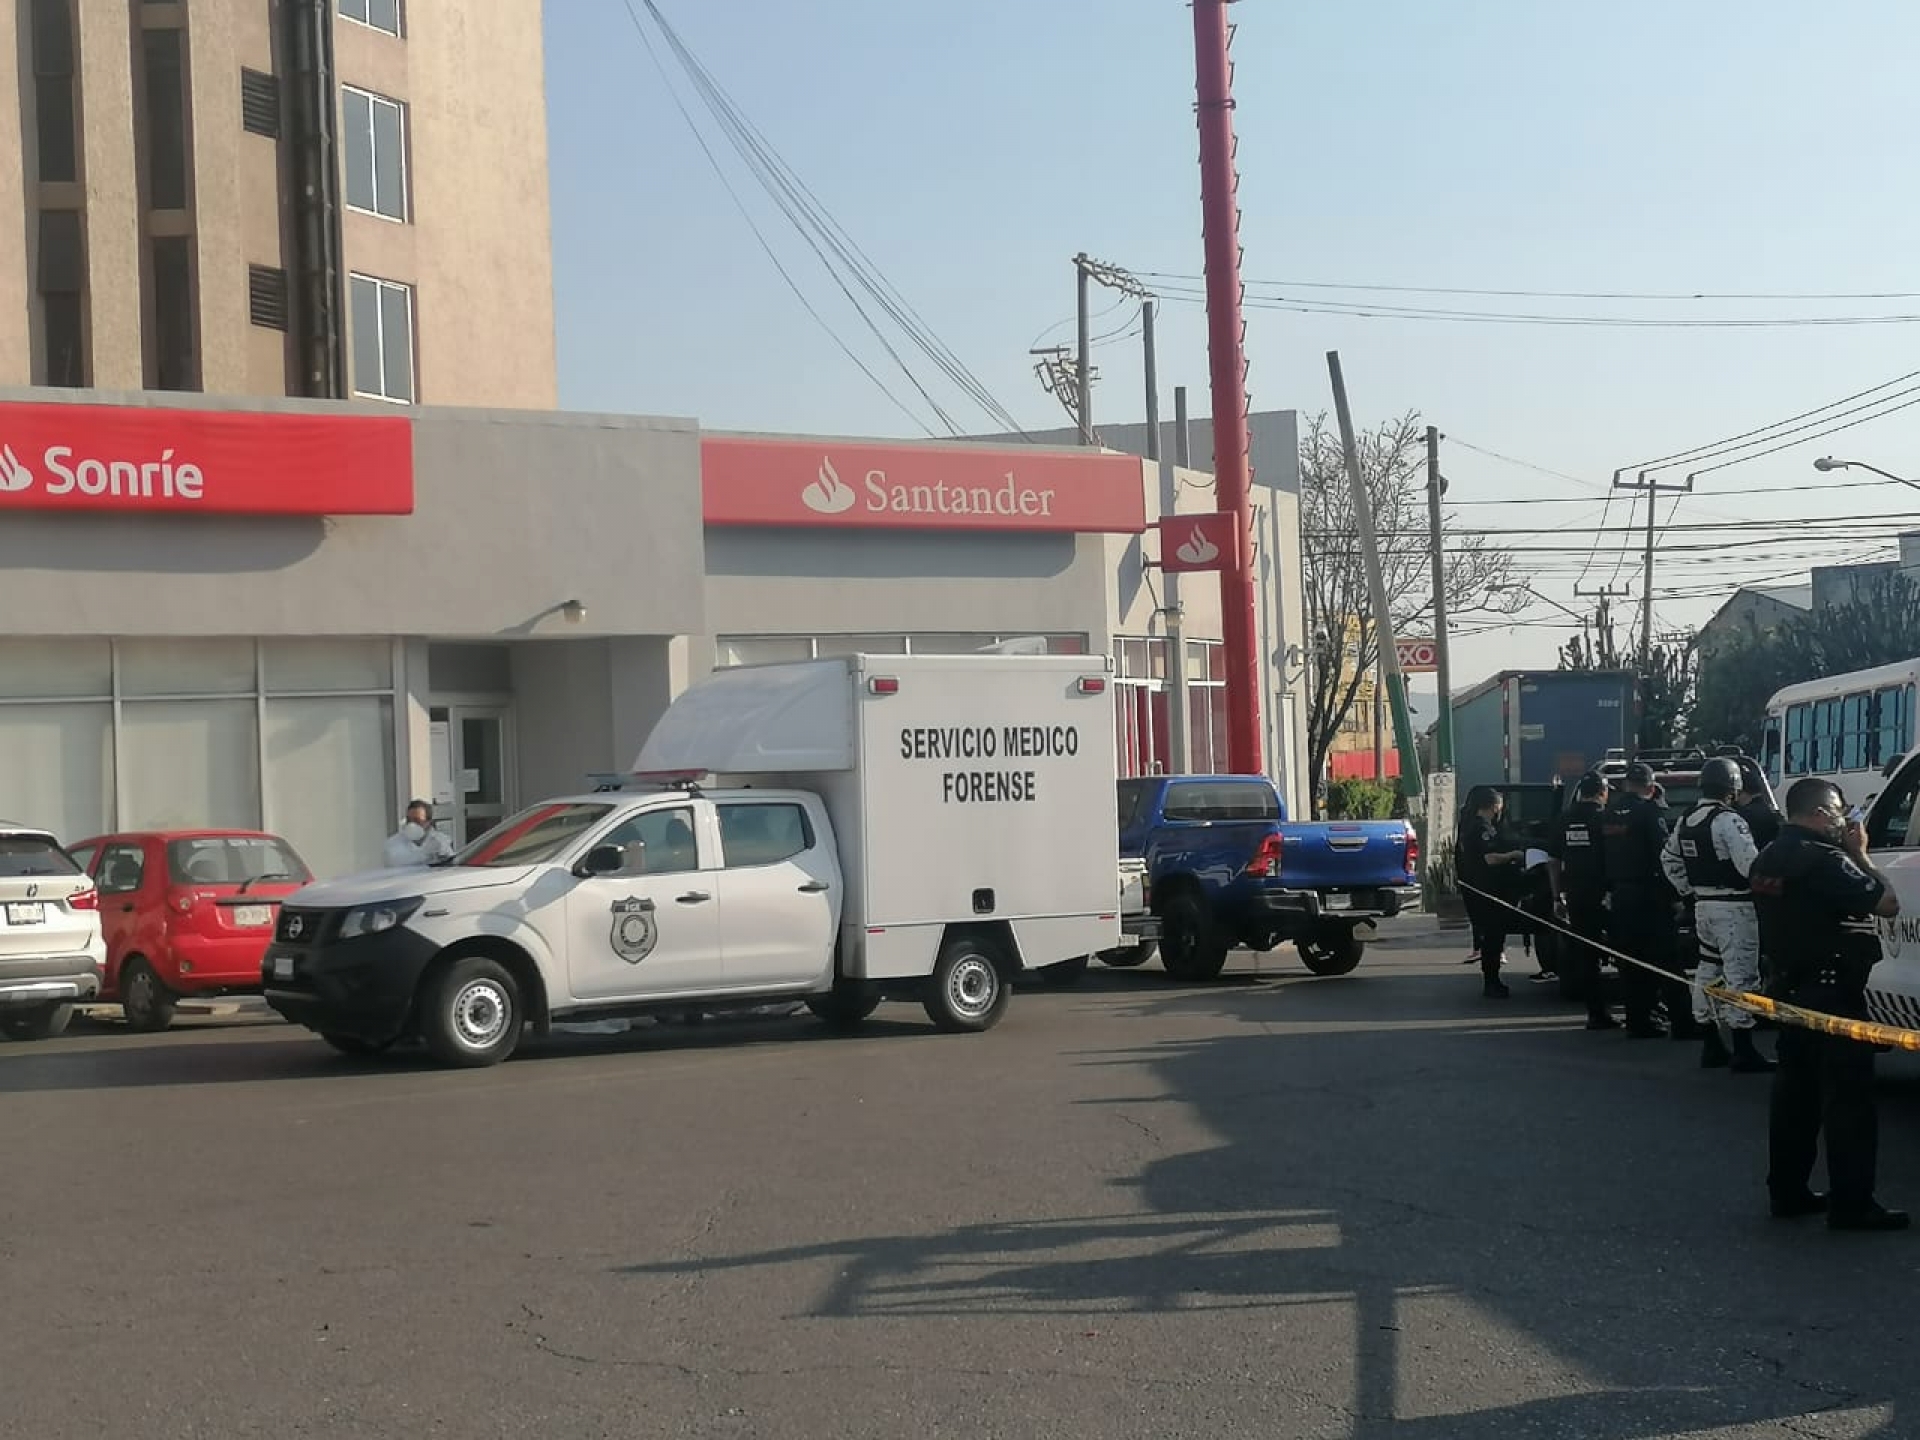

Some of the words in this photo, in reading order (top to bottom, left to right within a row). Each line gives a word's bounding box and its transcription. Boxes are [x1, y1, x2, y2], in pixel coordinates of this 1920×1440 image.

[44, 446, 204, 499] Sonríe
[865, 470, 1055, 516] Santander
[900, 727, 997, 759] SERVICIO
[1004, 726, 1079, 757] MEDICO
[943, 771, 1036, 803] FORENSE
